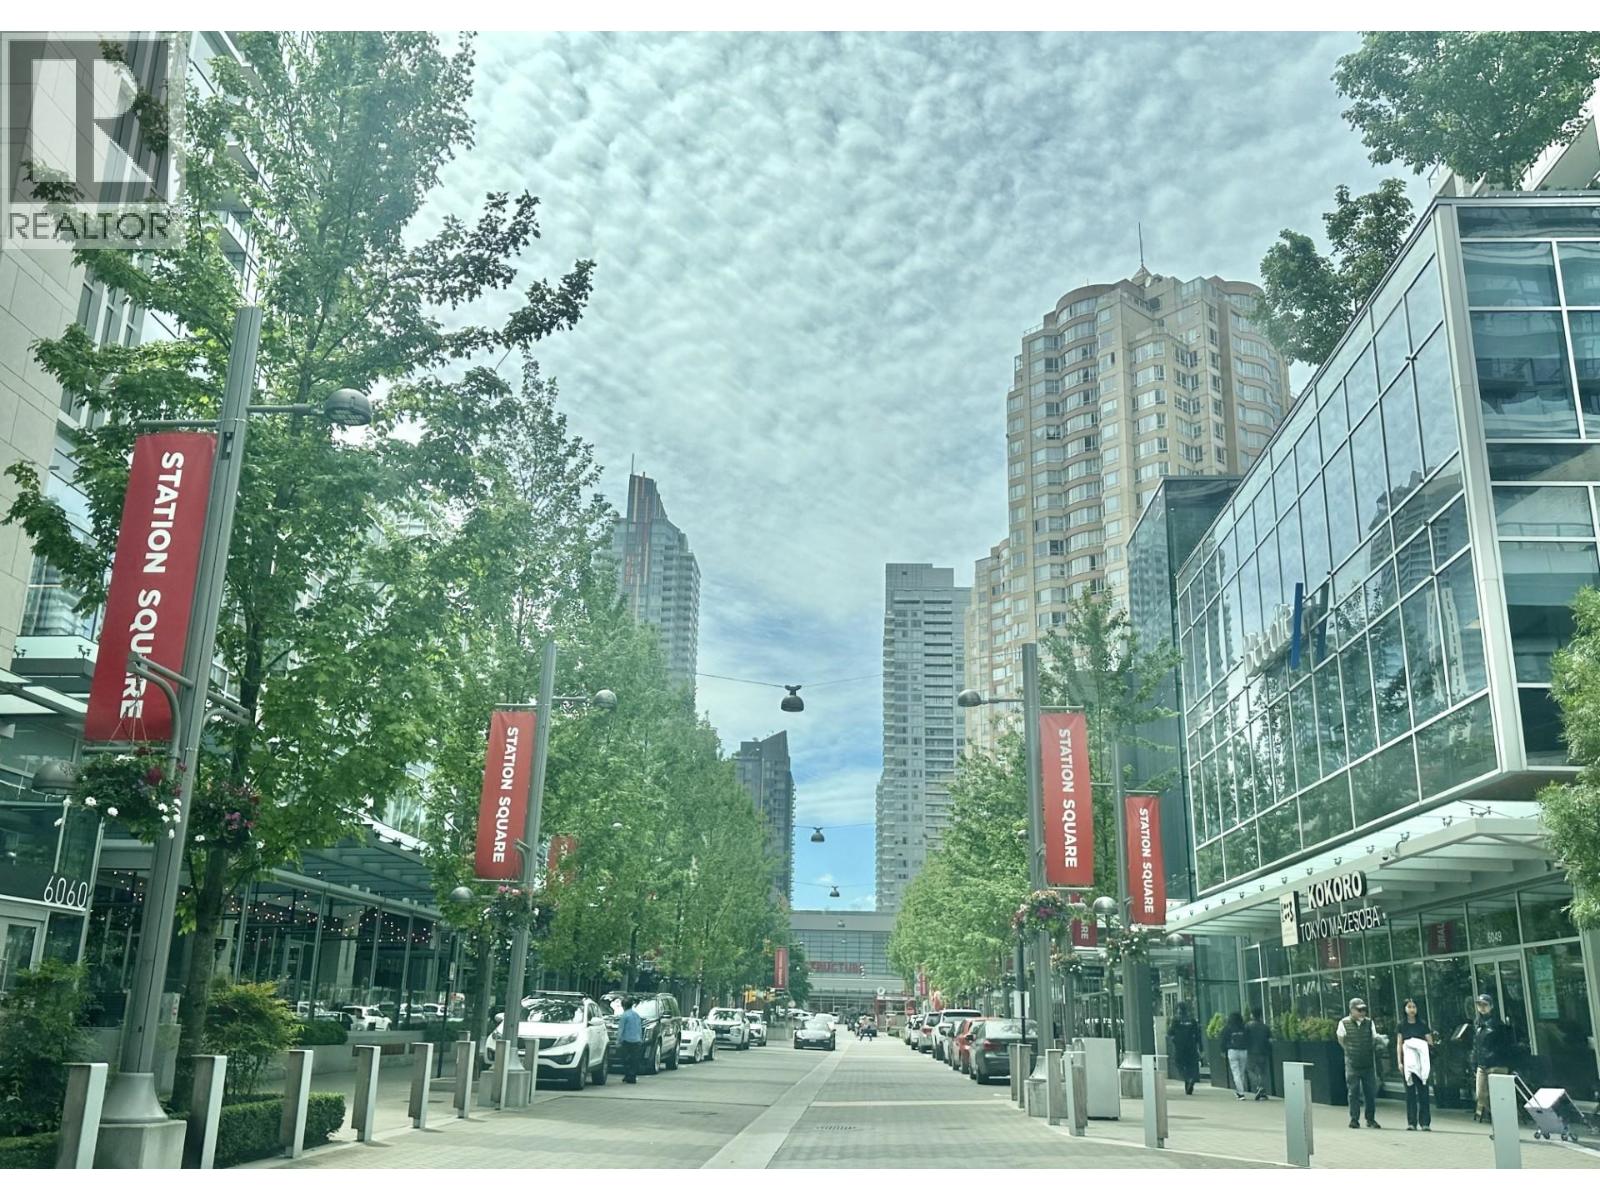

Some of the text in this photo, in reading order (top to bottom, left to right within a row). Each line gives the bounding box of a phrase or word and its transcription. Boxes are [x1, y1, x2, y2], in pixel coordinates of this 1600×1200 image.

[119, 451, 185, 719] STATION SQURE
[491, 726, 521, 864] STATION SQUARE
[1058, 728, 1078, 868] STATION SQUARE
[43, 875, 88, 908] 6060
[1138, 807, 1154, 914] STATION SQUARE
[1307, 870, 1363, 910] KOKORO
[1300, 918, 1328, 943] TOKYO
[1329, 905, 1381, 936] MAZESOBA
[1486, 930, 1503, 944] 6049
